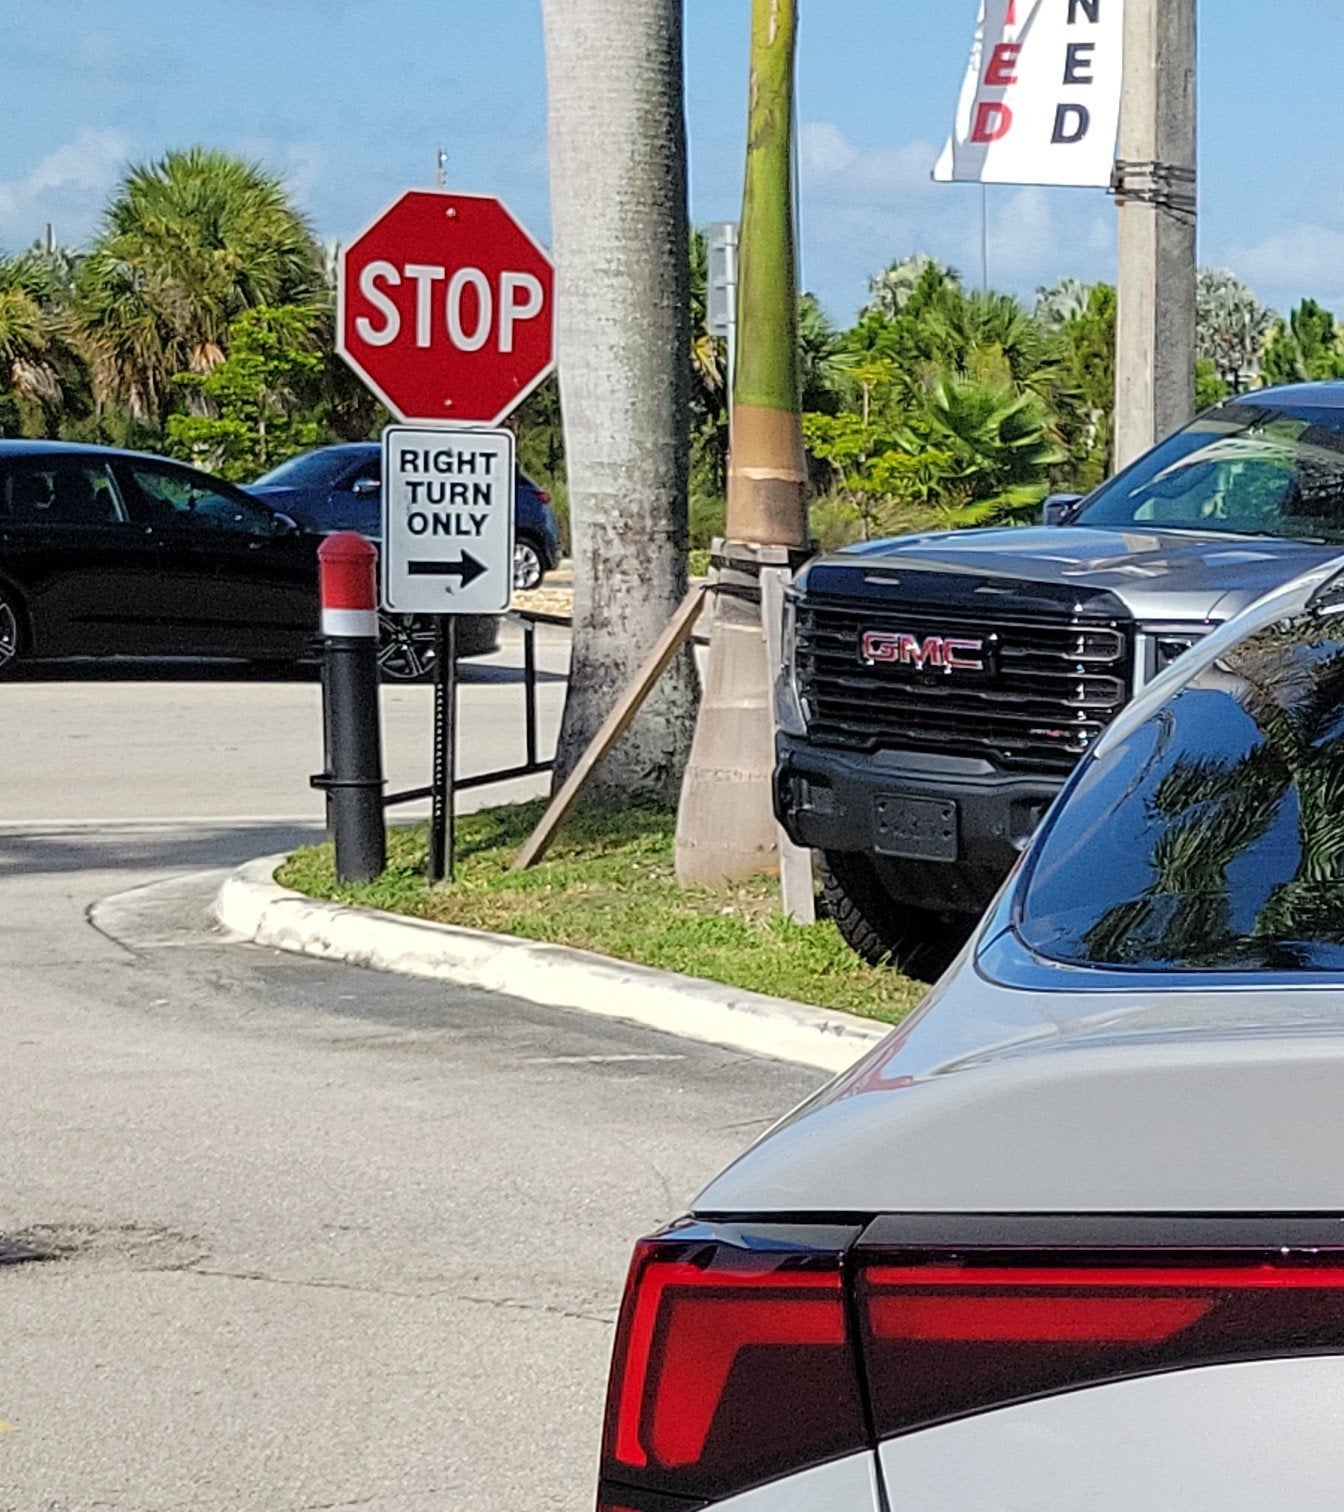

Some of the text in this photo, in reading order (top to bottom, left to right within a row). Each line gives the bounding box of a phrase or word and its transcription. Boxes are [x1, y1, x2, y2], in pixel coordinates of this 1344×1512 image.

[354, 259, 545, 354] STOP
[400, 449, 499, 476] RIGHT
[405, 481, 492, 506] TURN
[407, 511, 490, 537] ONLY
[862, 630, 983, 671] GMC
